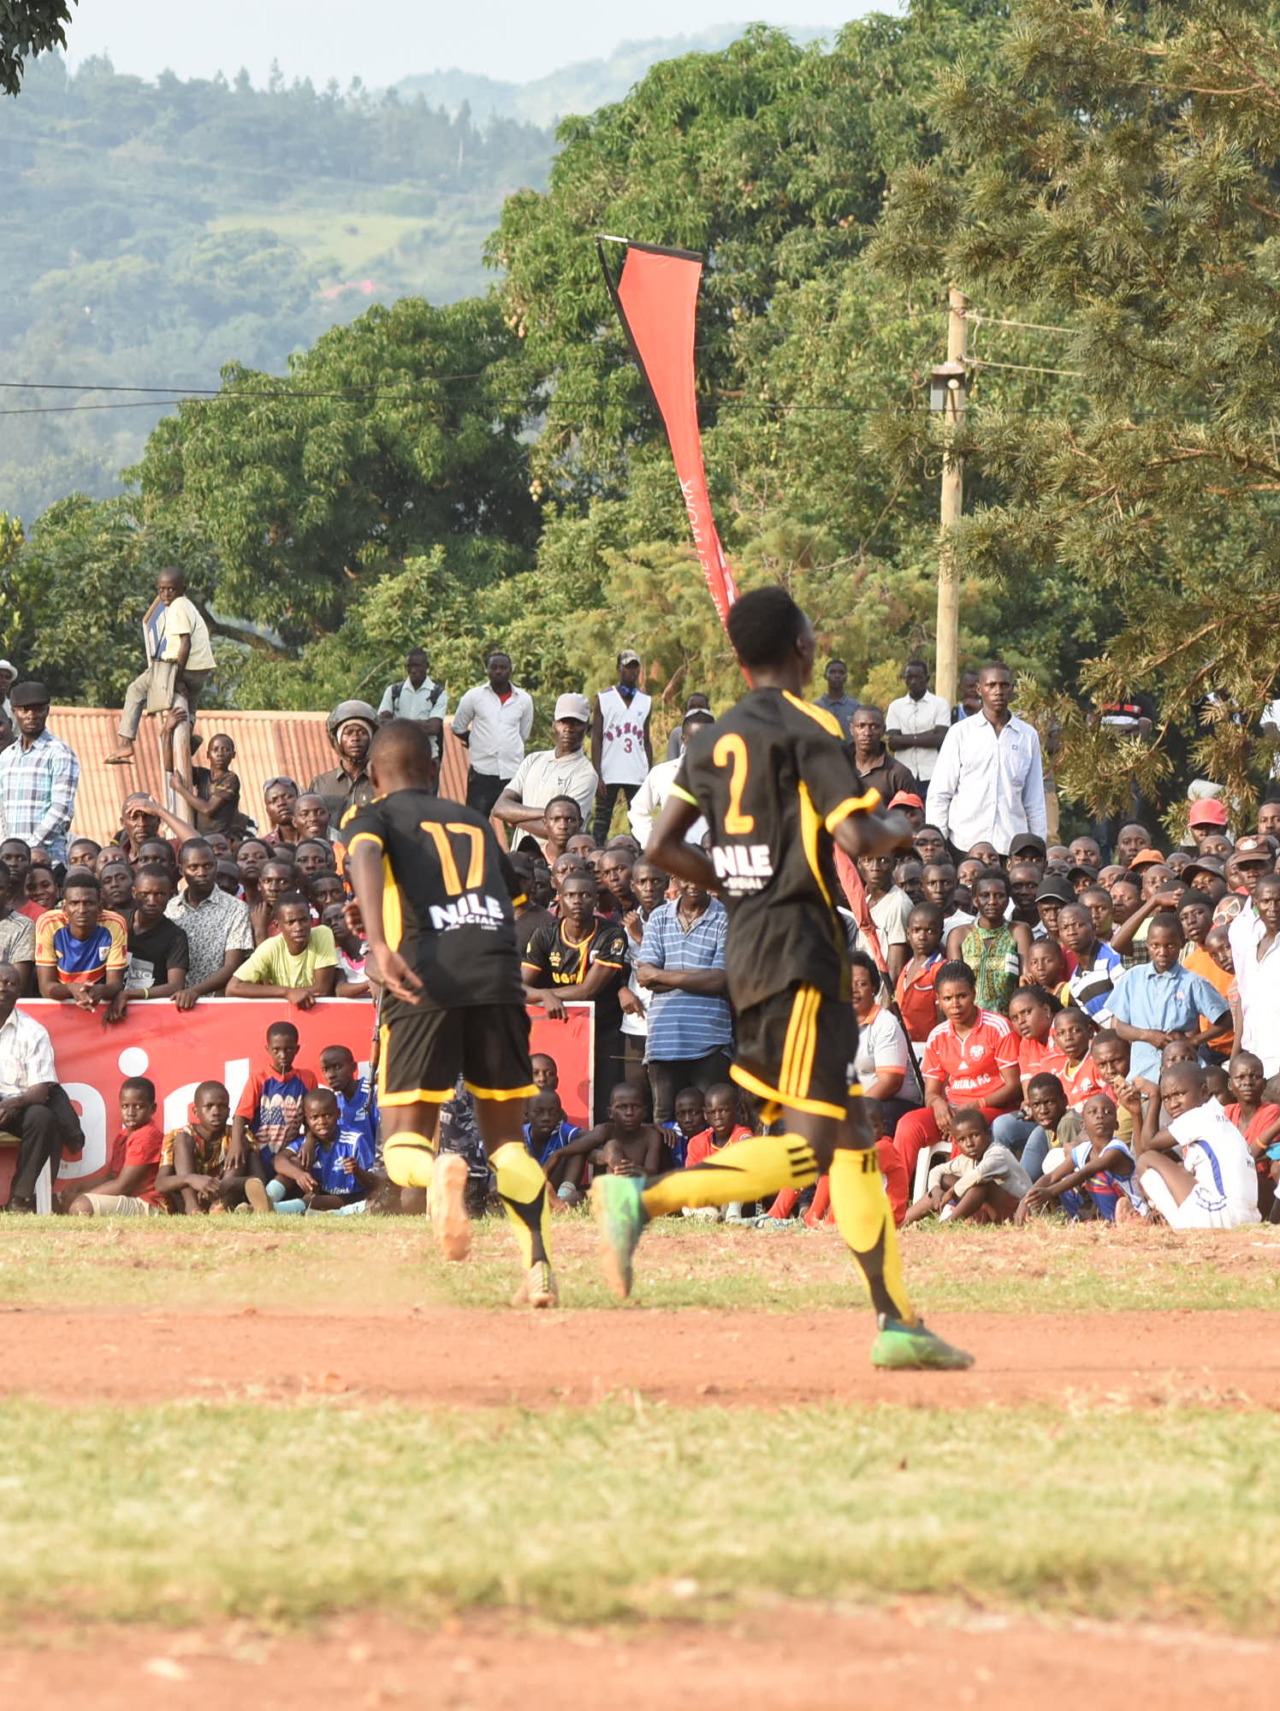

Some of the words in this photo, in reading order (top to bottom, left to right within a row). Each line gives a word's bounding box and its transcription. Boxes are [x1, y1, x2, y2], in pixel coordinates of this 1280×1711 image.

[623, 738, 633, 753] 3
[713, 732, 755, 835] 2
[420, 821, 485, 896] 17
[428, 893, 504, 930] NILE
